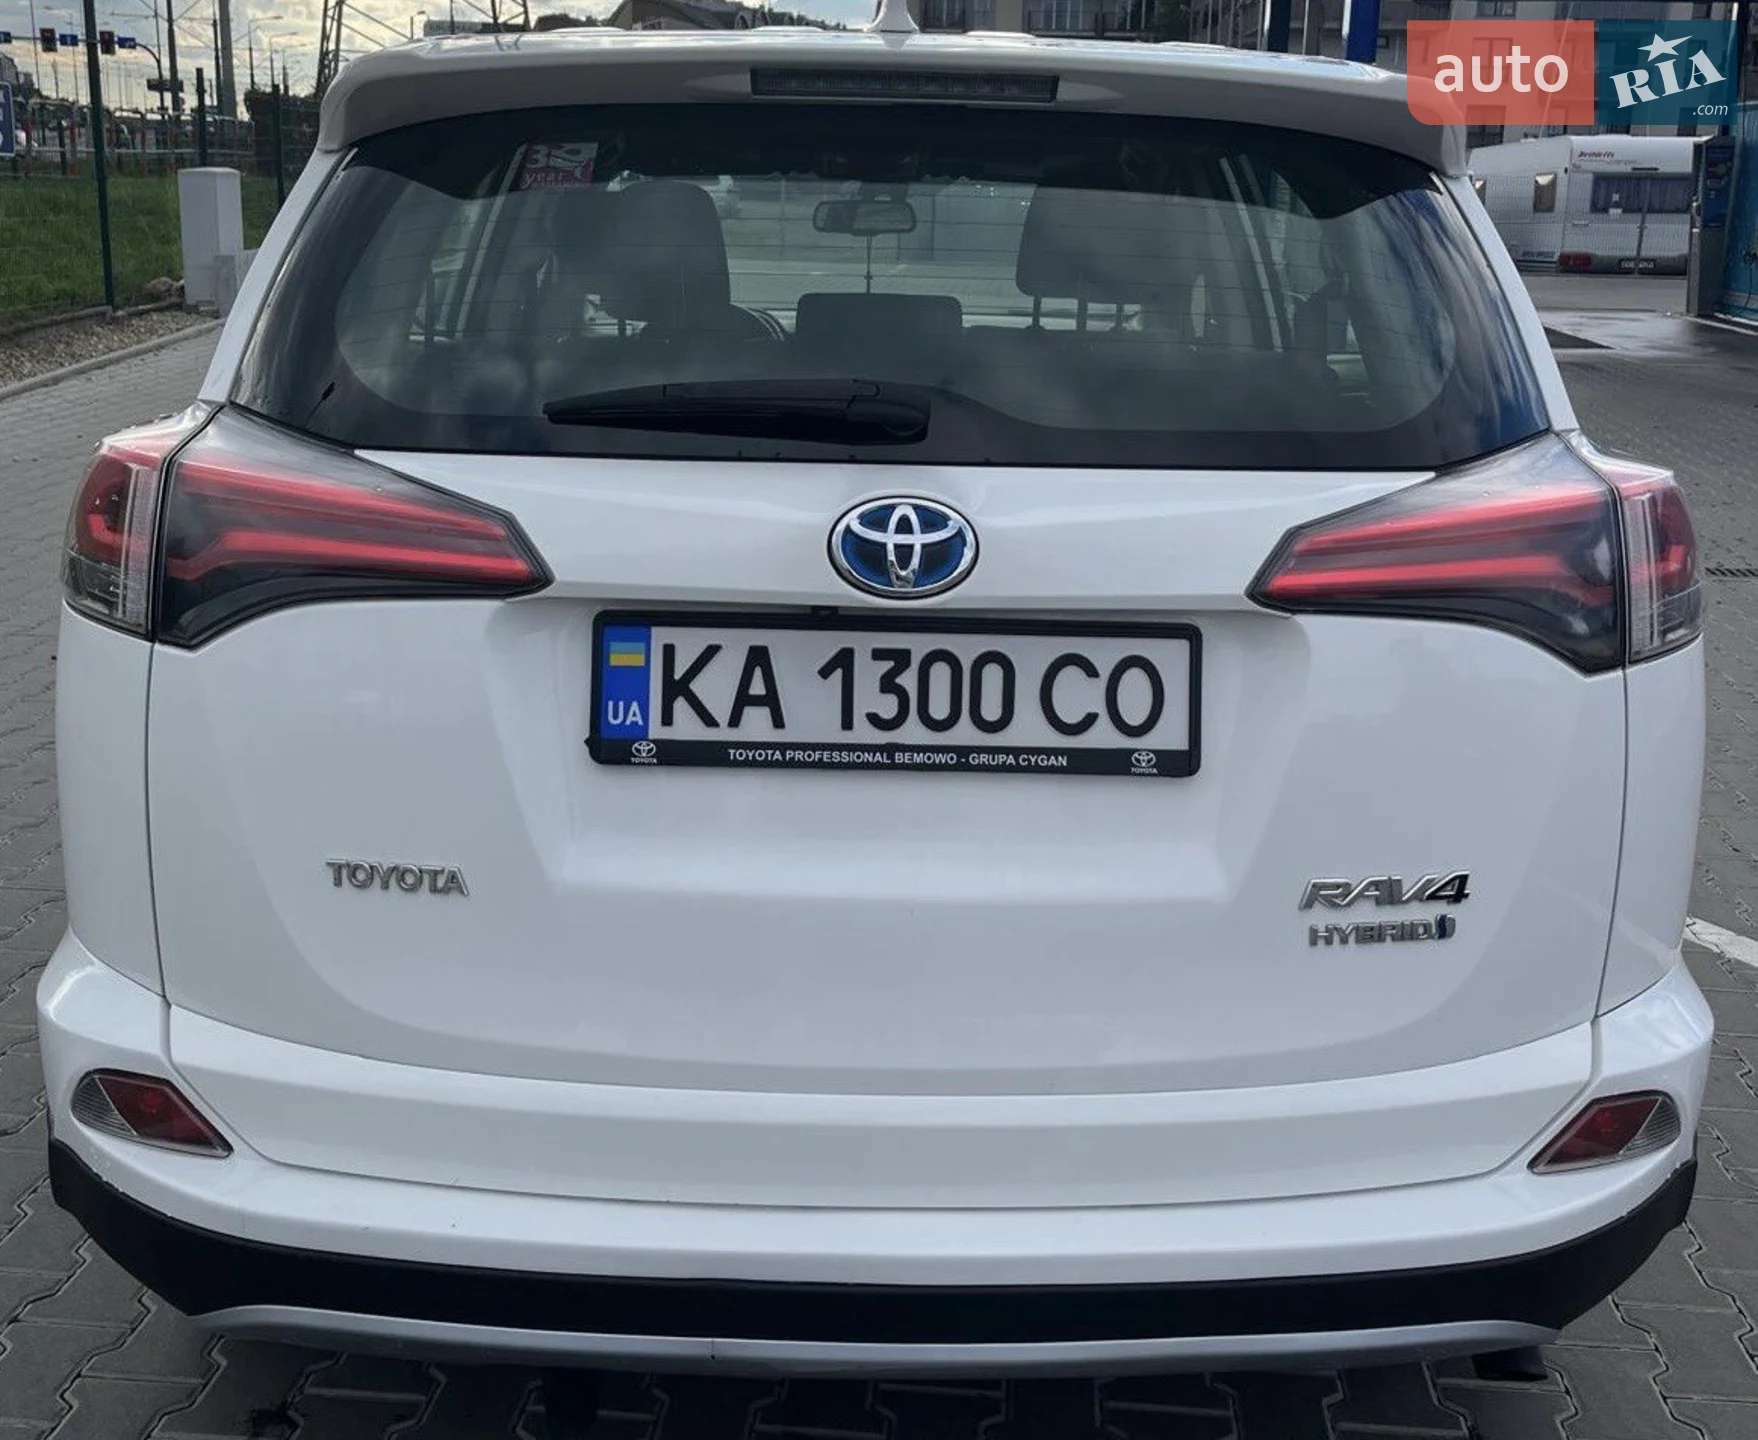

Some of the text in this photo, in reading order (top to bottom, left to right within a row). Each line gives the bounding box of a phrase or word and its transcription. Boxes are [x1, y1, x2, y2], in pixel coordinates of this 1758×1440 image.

[661, 643, 1166, 738] KA 1300 CO
[607, 701, 644, 726] UA
[728, 749, 782, 762] TOYOTA
[786, 751, 891, 764] PROFESSIONAL
[895, 752, 957, 765] BEMOWO
[969, 754, 1016, 766] GRUPA
[1019, 755, 1068, 767] CYGAN
[326, 858, 469, 896] TOYOTA
[1299, 870, 1471, 910] RAV4
[1309, 919, 1434, 947] HYBRID
